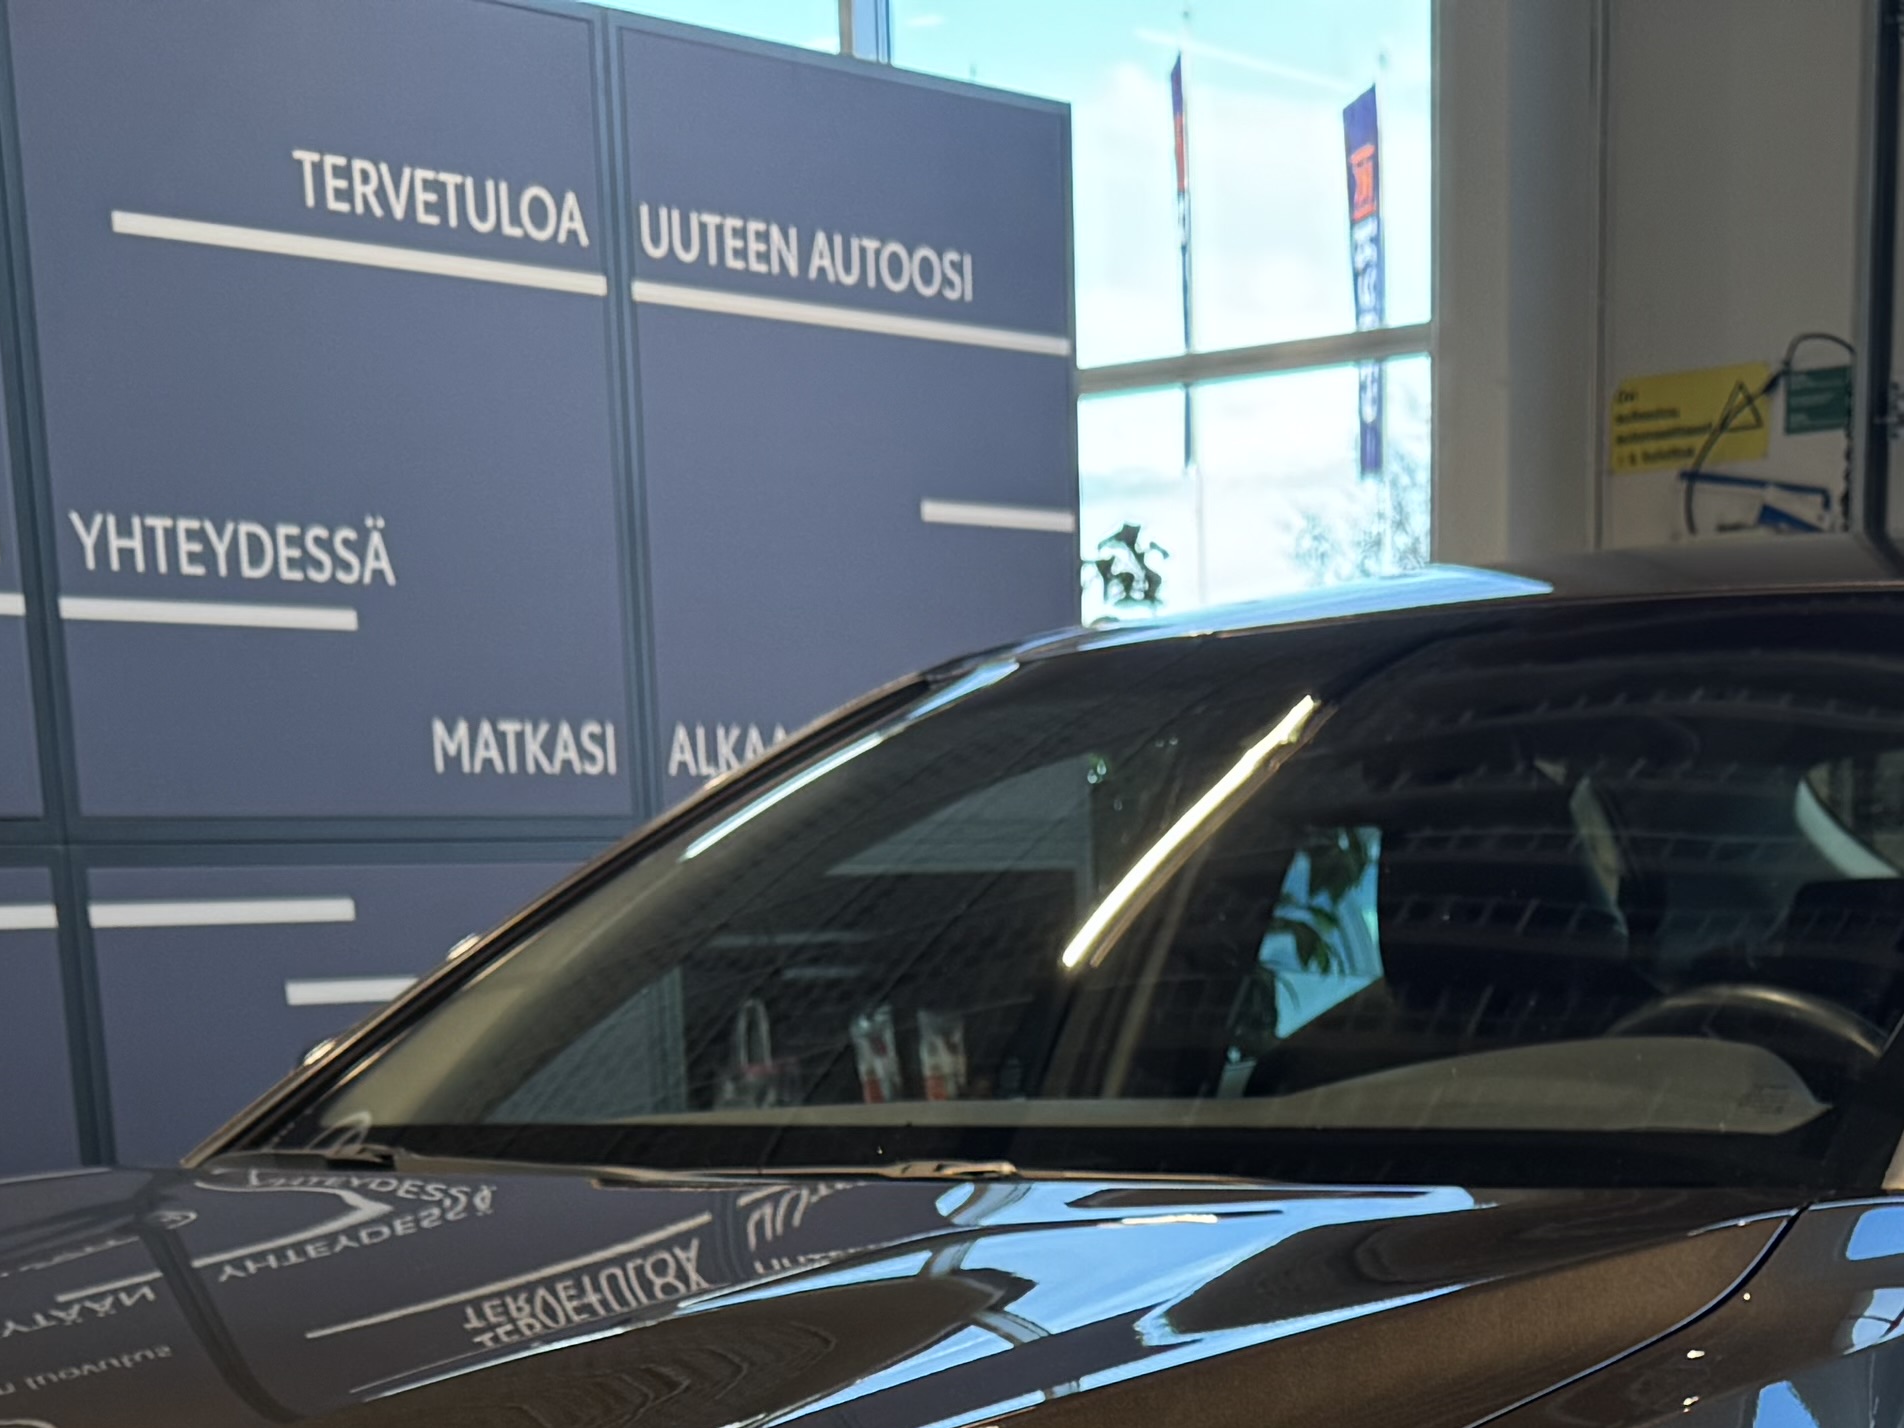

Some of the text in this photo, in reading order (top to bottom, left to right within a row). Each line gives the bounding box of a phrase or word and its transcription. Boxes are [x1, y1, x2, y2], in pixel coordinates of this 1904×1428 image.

[292, 146, 974, 303] TERVETULOA UUTEEN AUTOOSI
[68, 509, 397, 587] YHTEYDESSÄ
[431, 716, 618, 776] MATKASI
